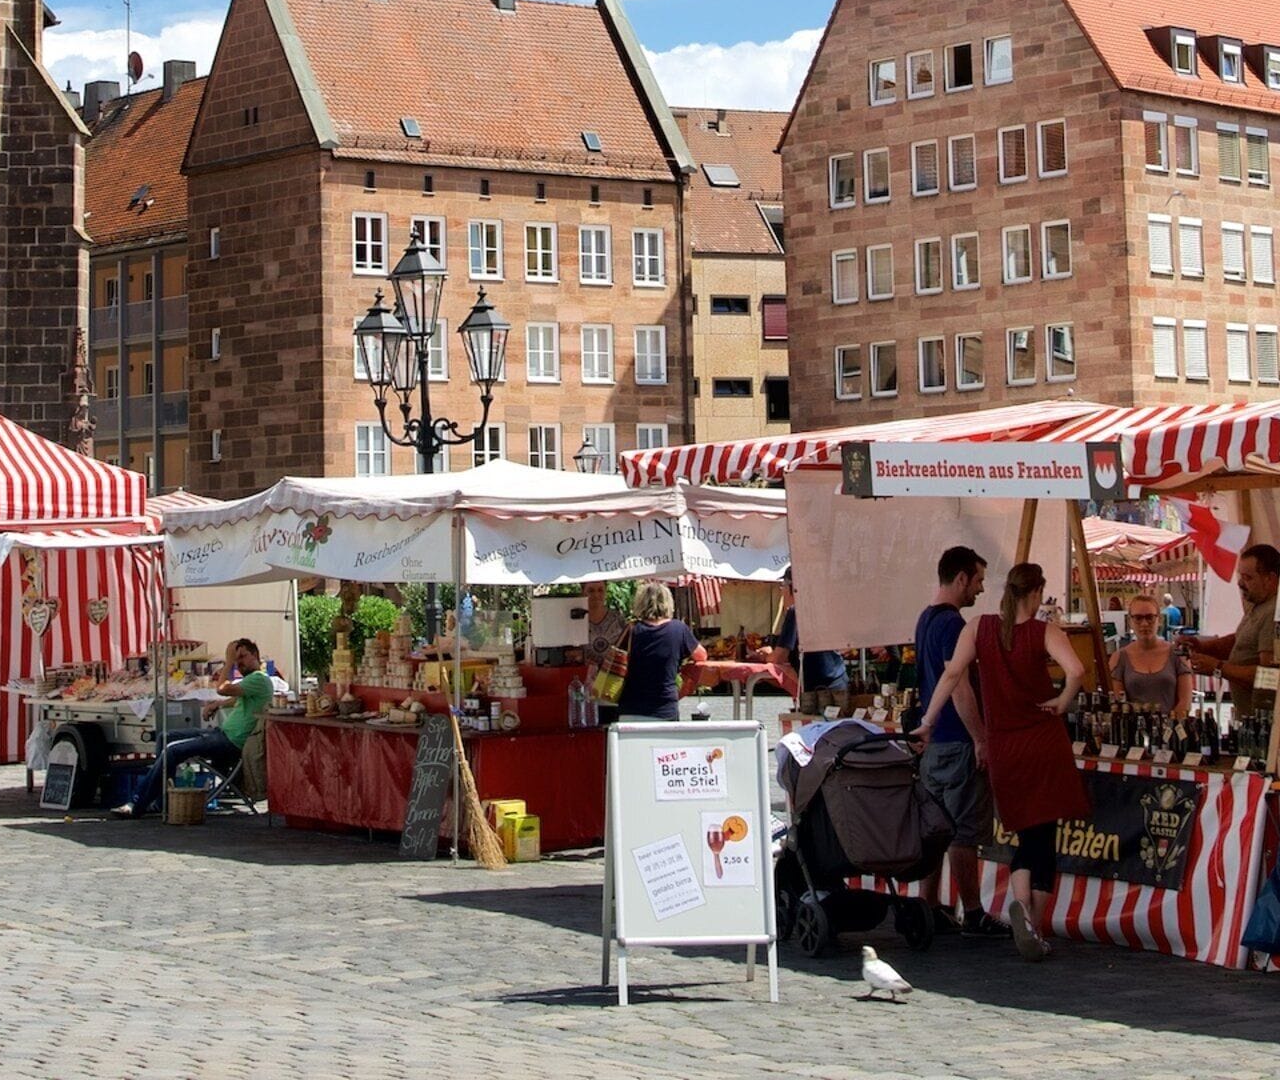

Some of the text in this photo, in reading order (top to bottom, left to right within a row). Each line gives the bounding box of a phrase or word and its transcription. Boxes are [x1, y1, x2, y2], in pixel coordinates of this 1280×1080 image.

[875, 460, 986, 479] Bierkreationen
[989, 464, 1014, 479] aus
[1017, 461, 1083, 479] Franken
[557, 521, 644, 555] Original
[473, 539, 528, 566] Sausages
[592, 549, 675, 573] Traditional
[401, 556, 423, 568] Ohne
[662, 764, 708, 777] Biereis
[667, 775, 719, 788] am Stiel
[1150, 810, 1181, 828] RED
[723, 856, 750, 865] 2,50 €
